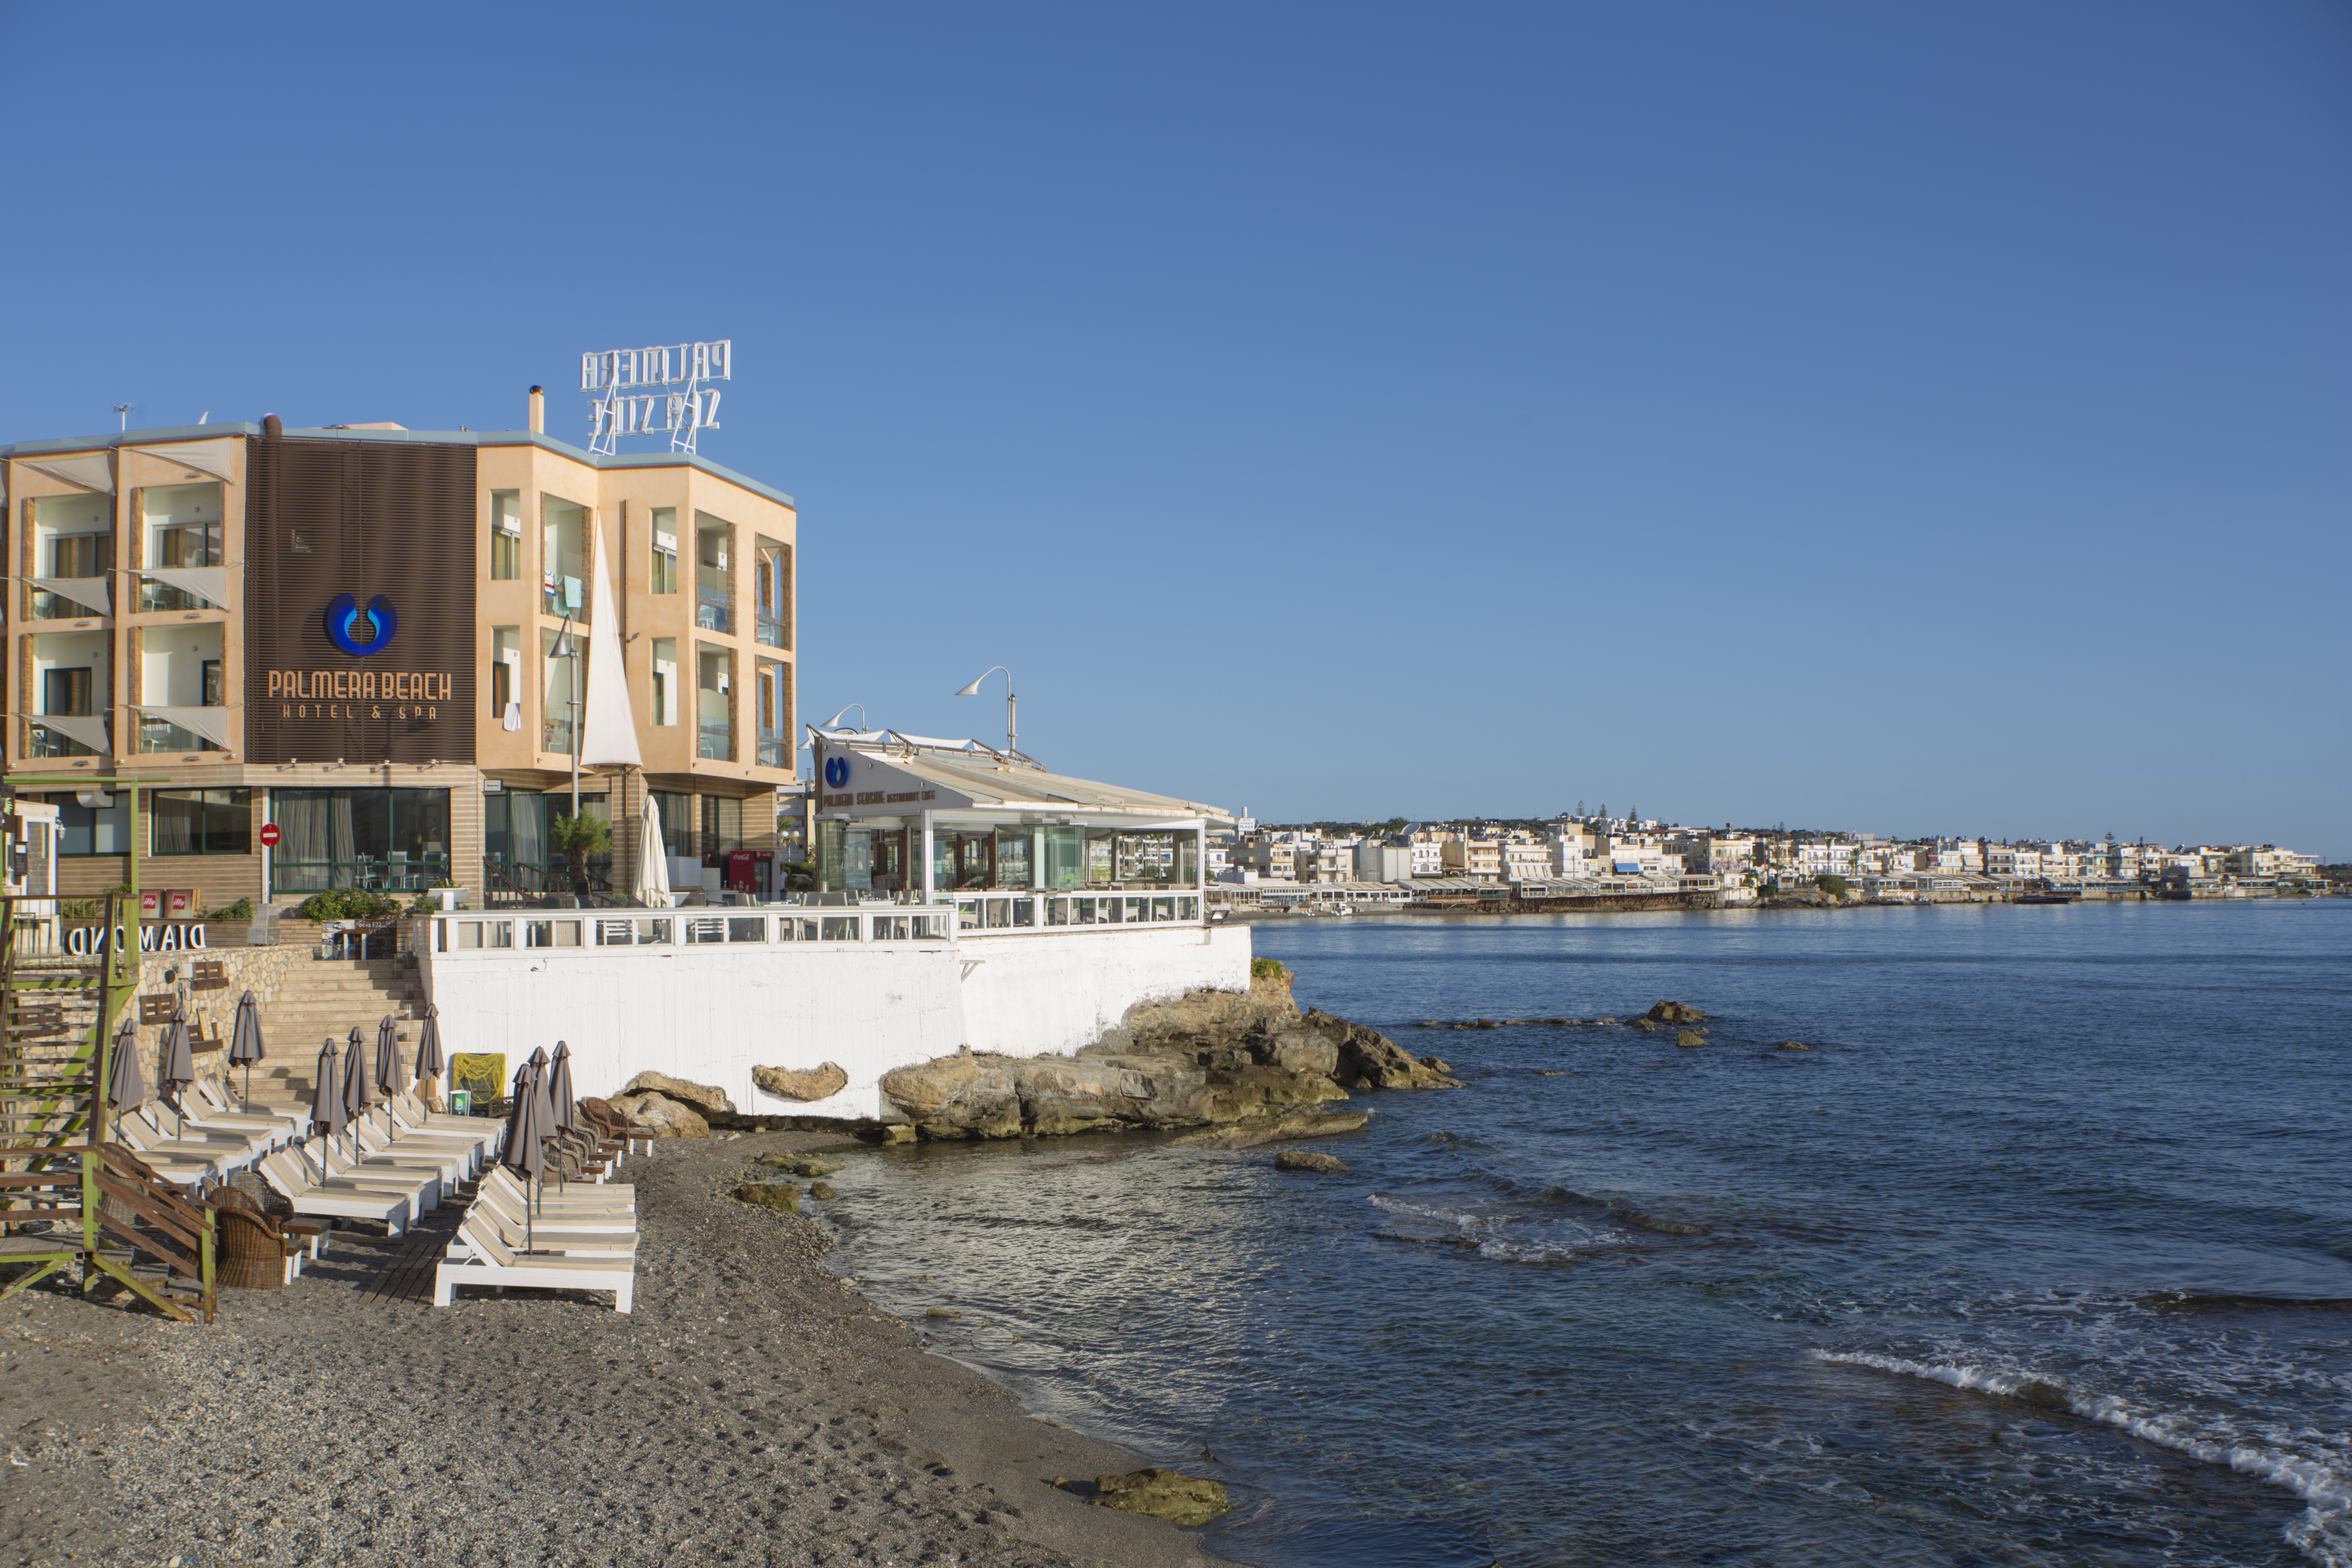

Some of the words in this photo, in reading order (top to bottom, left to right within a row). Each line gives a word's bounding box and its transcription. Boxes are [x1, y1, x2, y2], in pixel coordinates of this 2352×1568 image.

[268, 670, 375, 699] PALMERA
[382, 672, 451, 700] BEACH
[282, 704, 353, 718] HOTEL
[371, 705, 381, 719] &
[399, 706, 437, 720] SPA
[823, 793, 854, 807] PALMERA
[857, 791, 885, 805] SEASIDE
[144, 897, 156, 906] illy
[173, 898, 185, 906] illy
